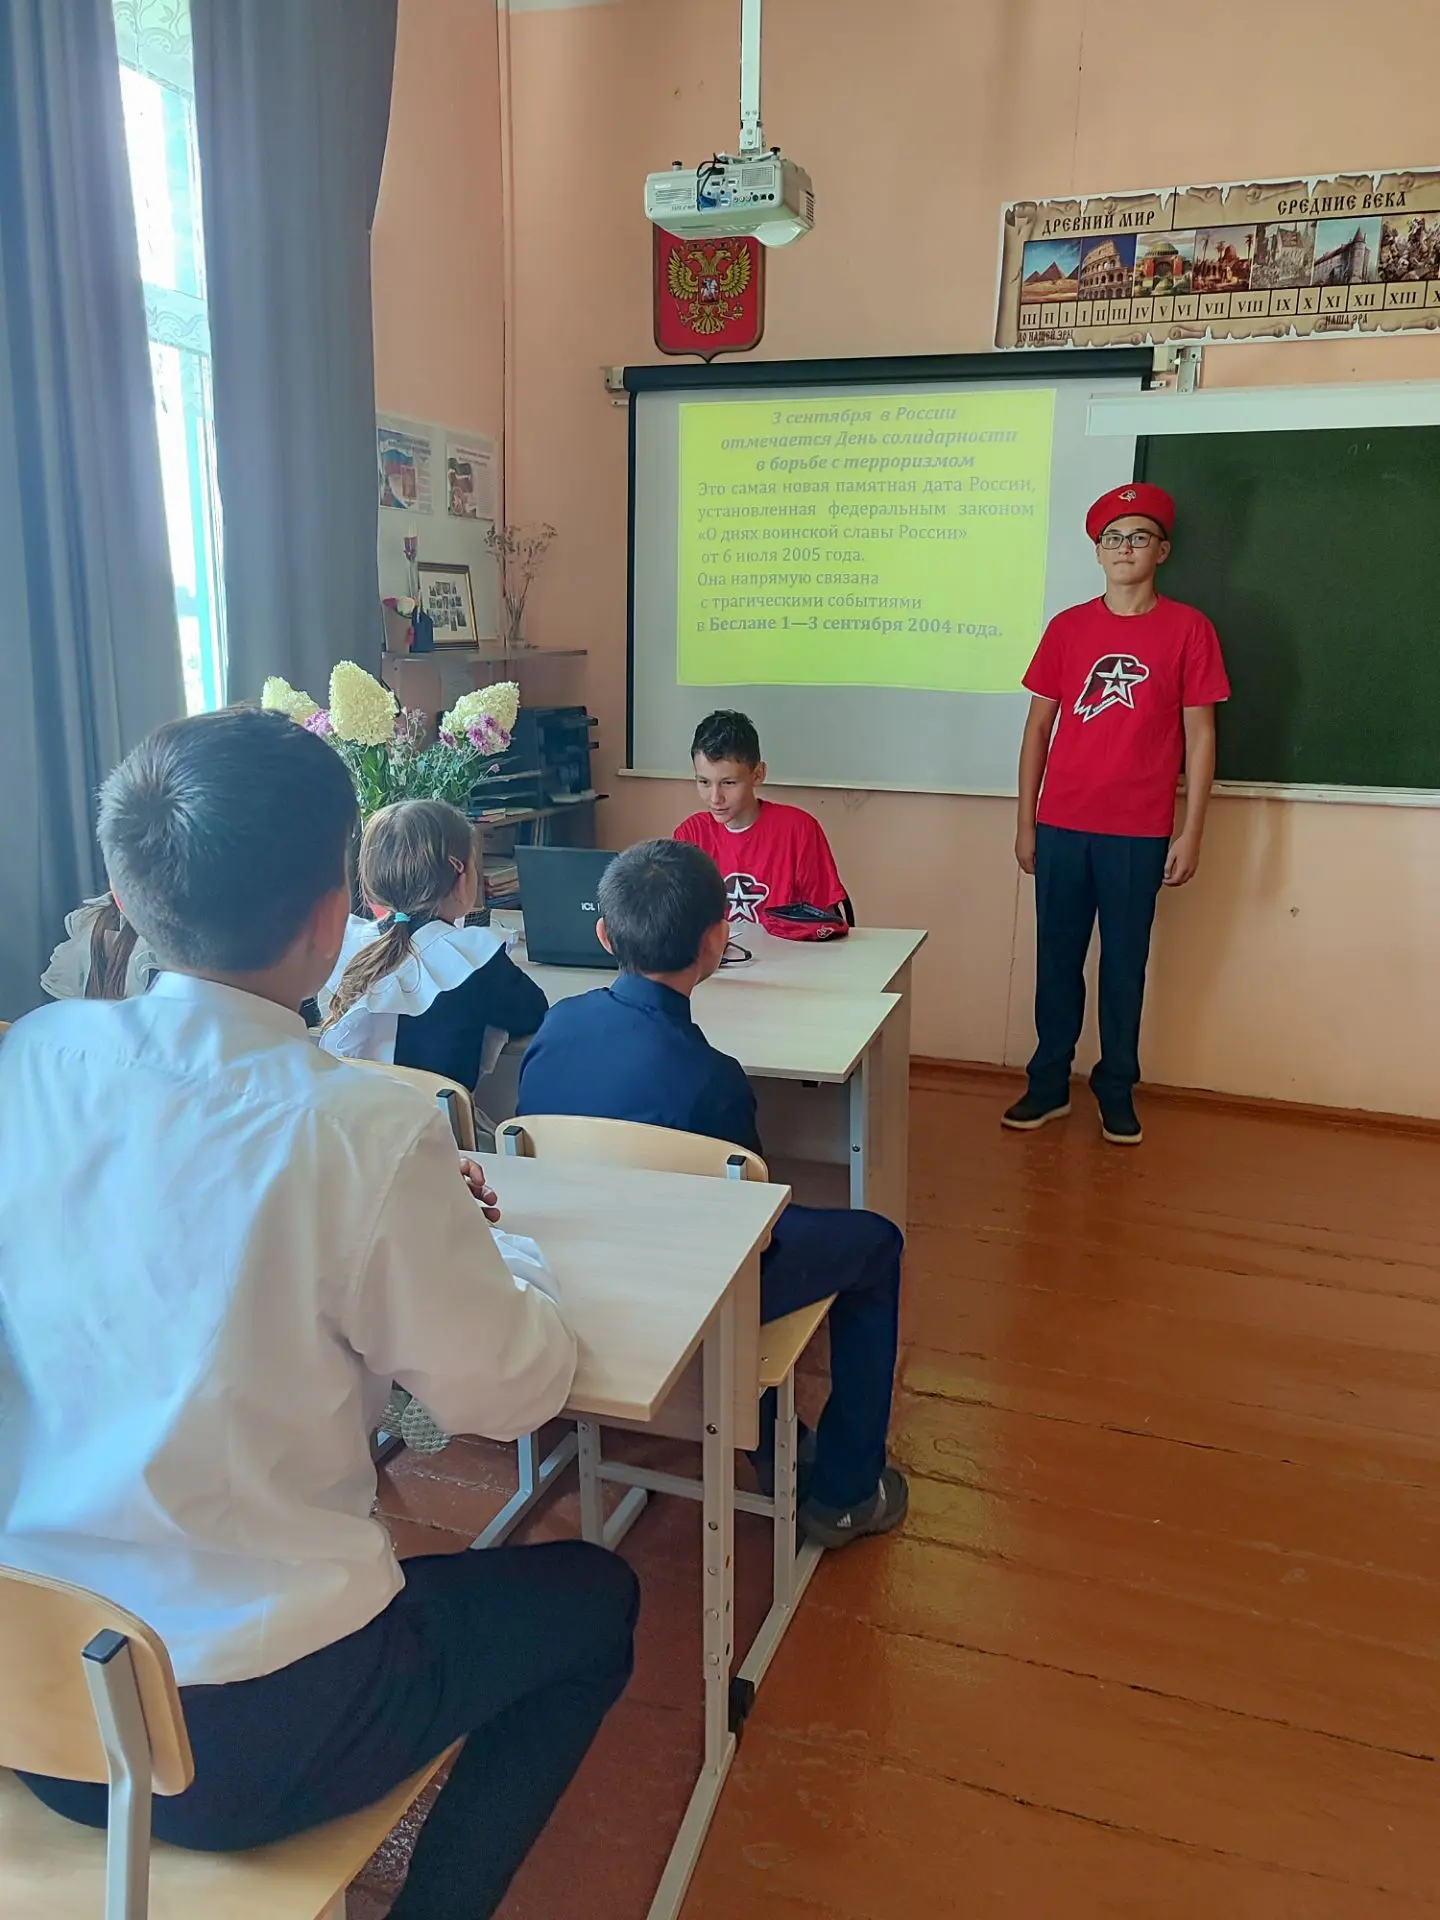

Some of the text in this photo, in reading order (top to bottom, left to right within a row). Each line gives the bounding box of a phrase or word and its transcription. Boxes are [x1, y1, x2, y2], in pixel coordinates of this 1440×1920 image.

[1278, 191, 1406, 216] СРЕДНИЕ ВЕКА
[1042, 210, 1155, 236] ДРЕВНИЙ МИР
[1022, 313, 1036, 325] III
[1045, 312, 1054, 324] II
[1096, 309, 1105, 321] II
[1112, 308, 1127, 320] III
[1135, 306, 1151, 319] IV
[1177, 304, 1192, 316] VI
[1205, 302, 1225, 315] VII
[1238, 300, 1263, 313] VIII
[1276, 298, 1292, 311] IX
[1325, 295, 1341, 308] XI
[1353, 293, 1375, 306] XII
[1389, 291, 1416, 305] XIII
[1325, 313, 1368, 326] НАША ЭРА
[772, 406, 957, 426] 3 сентября в России
[720, 428, 1018, 450] отмечается День солидарности
[756, 454, 975, 474] в борьбе с терроризмом
[698, 476, 1036, 496] Это самая новая памятная дата России,
[697, 499, 1035, 522] установленная федеральным законом
[698, 524, 967, 544] «О днях воинской славы России»
[701, 547, 865, 564] от 6 июля 2005 года.
[697, 572, 879, 588] Она напрямую связана
[700, 593, 922, 611] с трагическими событиями
[697, 620, 705, 632] в
[709, 616, 776, 631] Беслане
[823, 616, 902, 635] сентября
[907, 617, 952, 634] 2004
[957, 622, 1003, 639] года.
